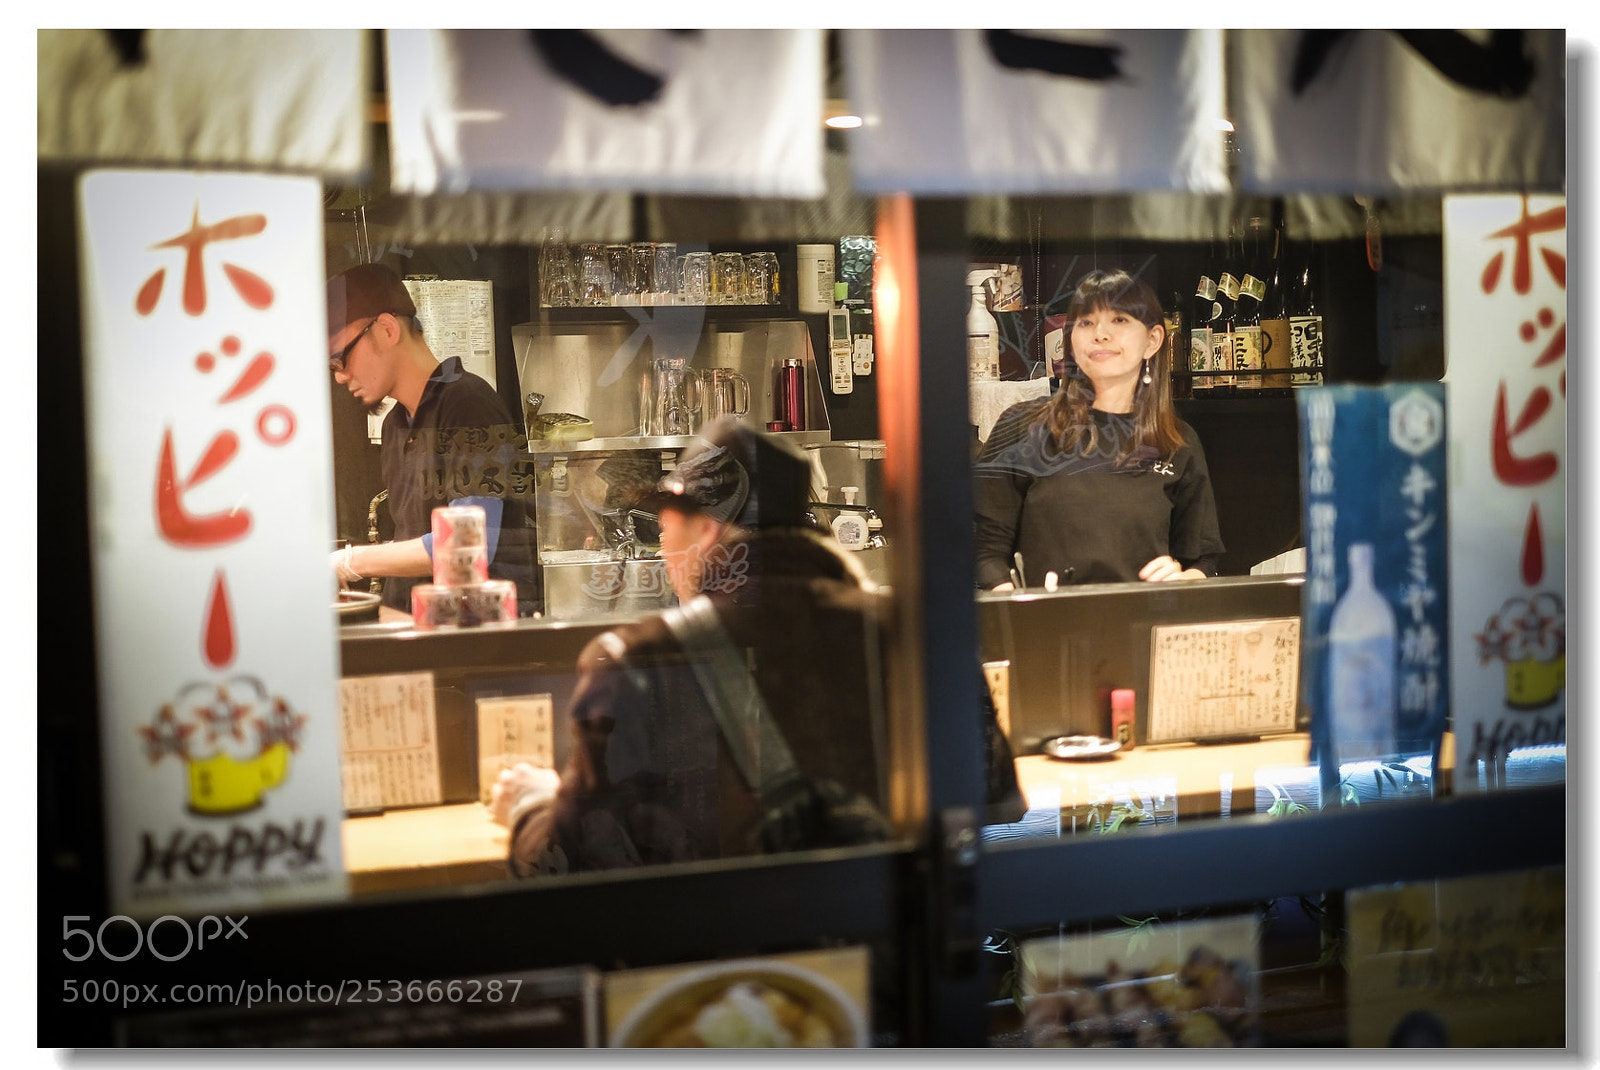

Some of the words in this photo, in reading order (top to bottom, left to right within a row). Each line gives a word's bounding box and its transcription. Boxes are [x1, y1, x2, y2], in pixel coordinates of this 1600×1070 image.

[134, 200, 297, 671] ホッピー
[133, 818, 327, 883] HOPPY
